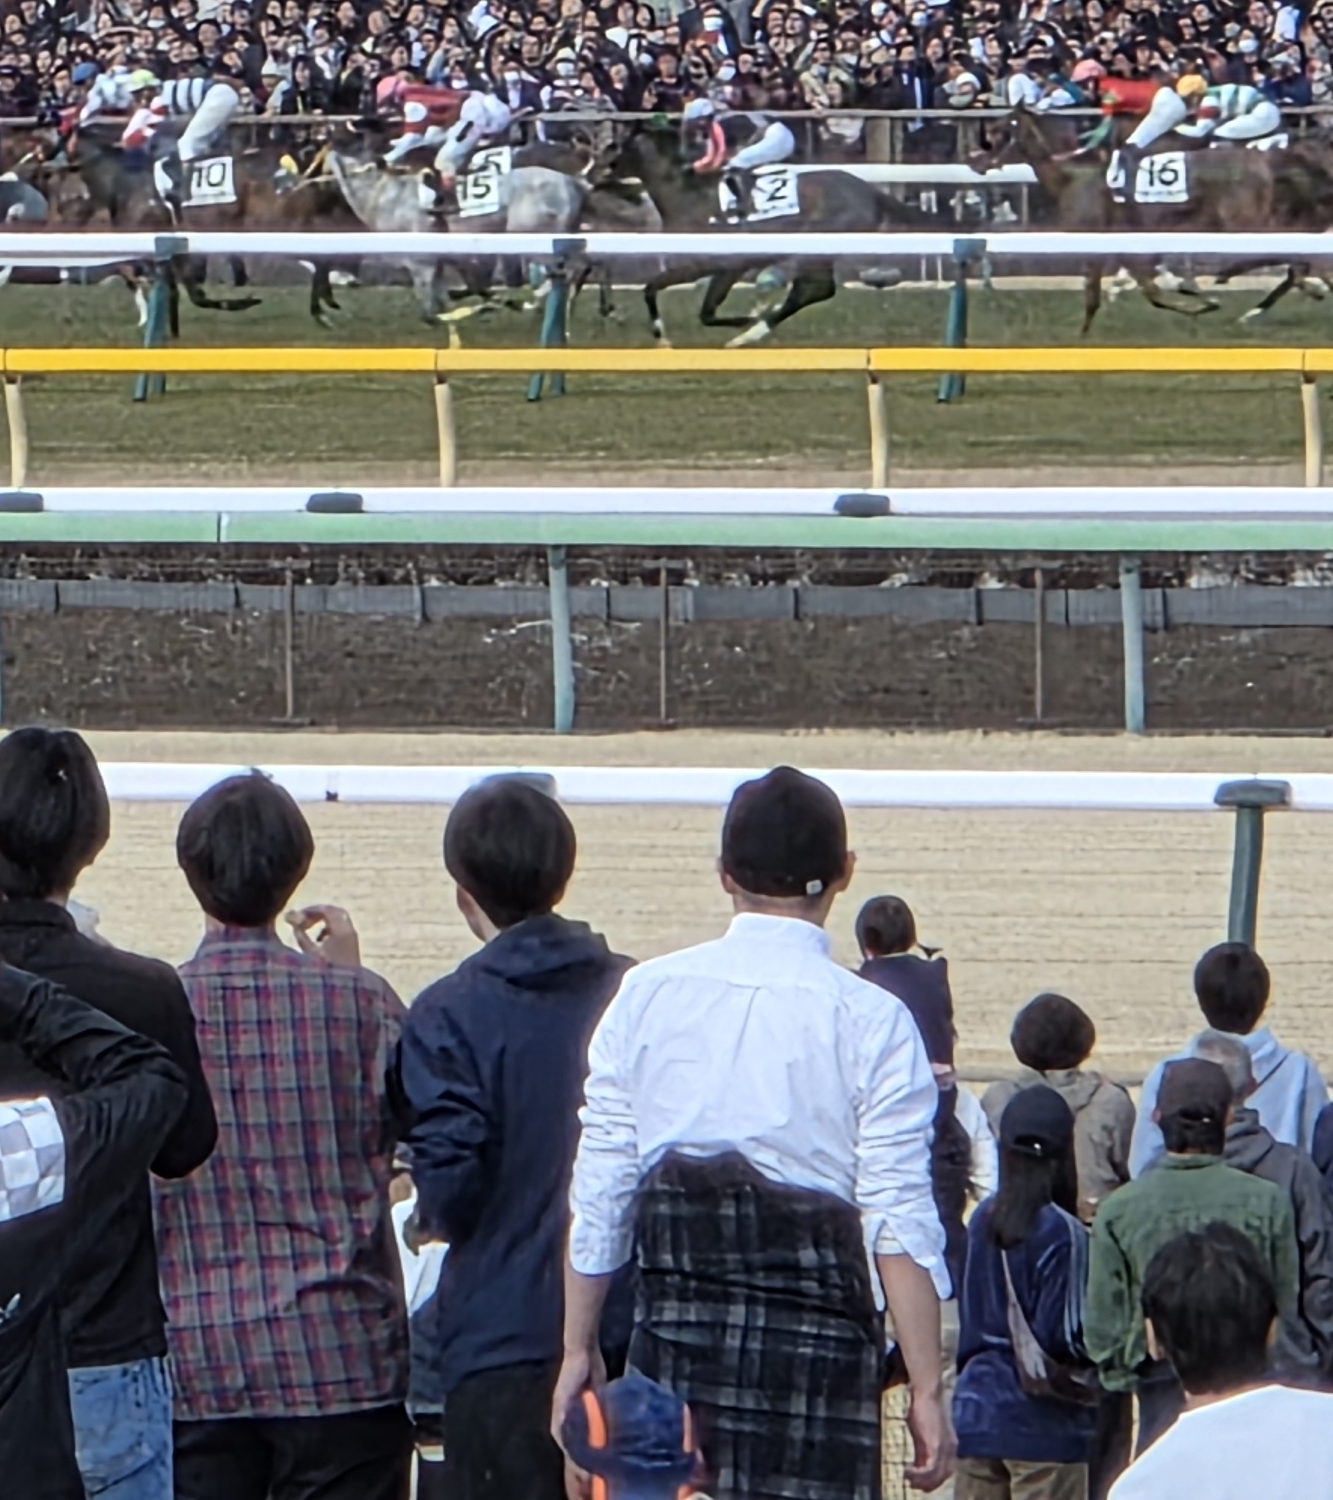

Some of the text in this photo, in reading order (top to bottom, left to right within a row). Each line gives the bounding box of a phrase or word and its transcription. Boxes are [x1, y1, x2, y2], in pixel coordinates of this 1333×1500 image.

[192, 162, 226, 188] 10
[1147, 159, 1180, 187] 16
[458, 175, 491, 200] 15
[766, 177, 788, 202] 2
